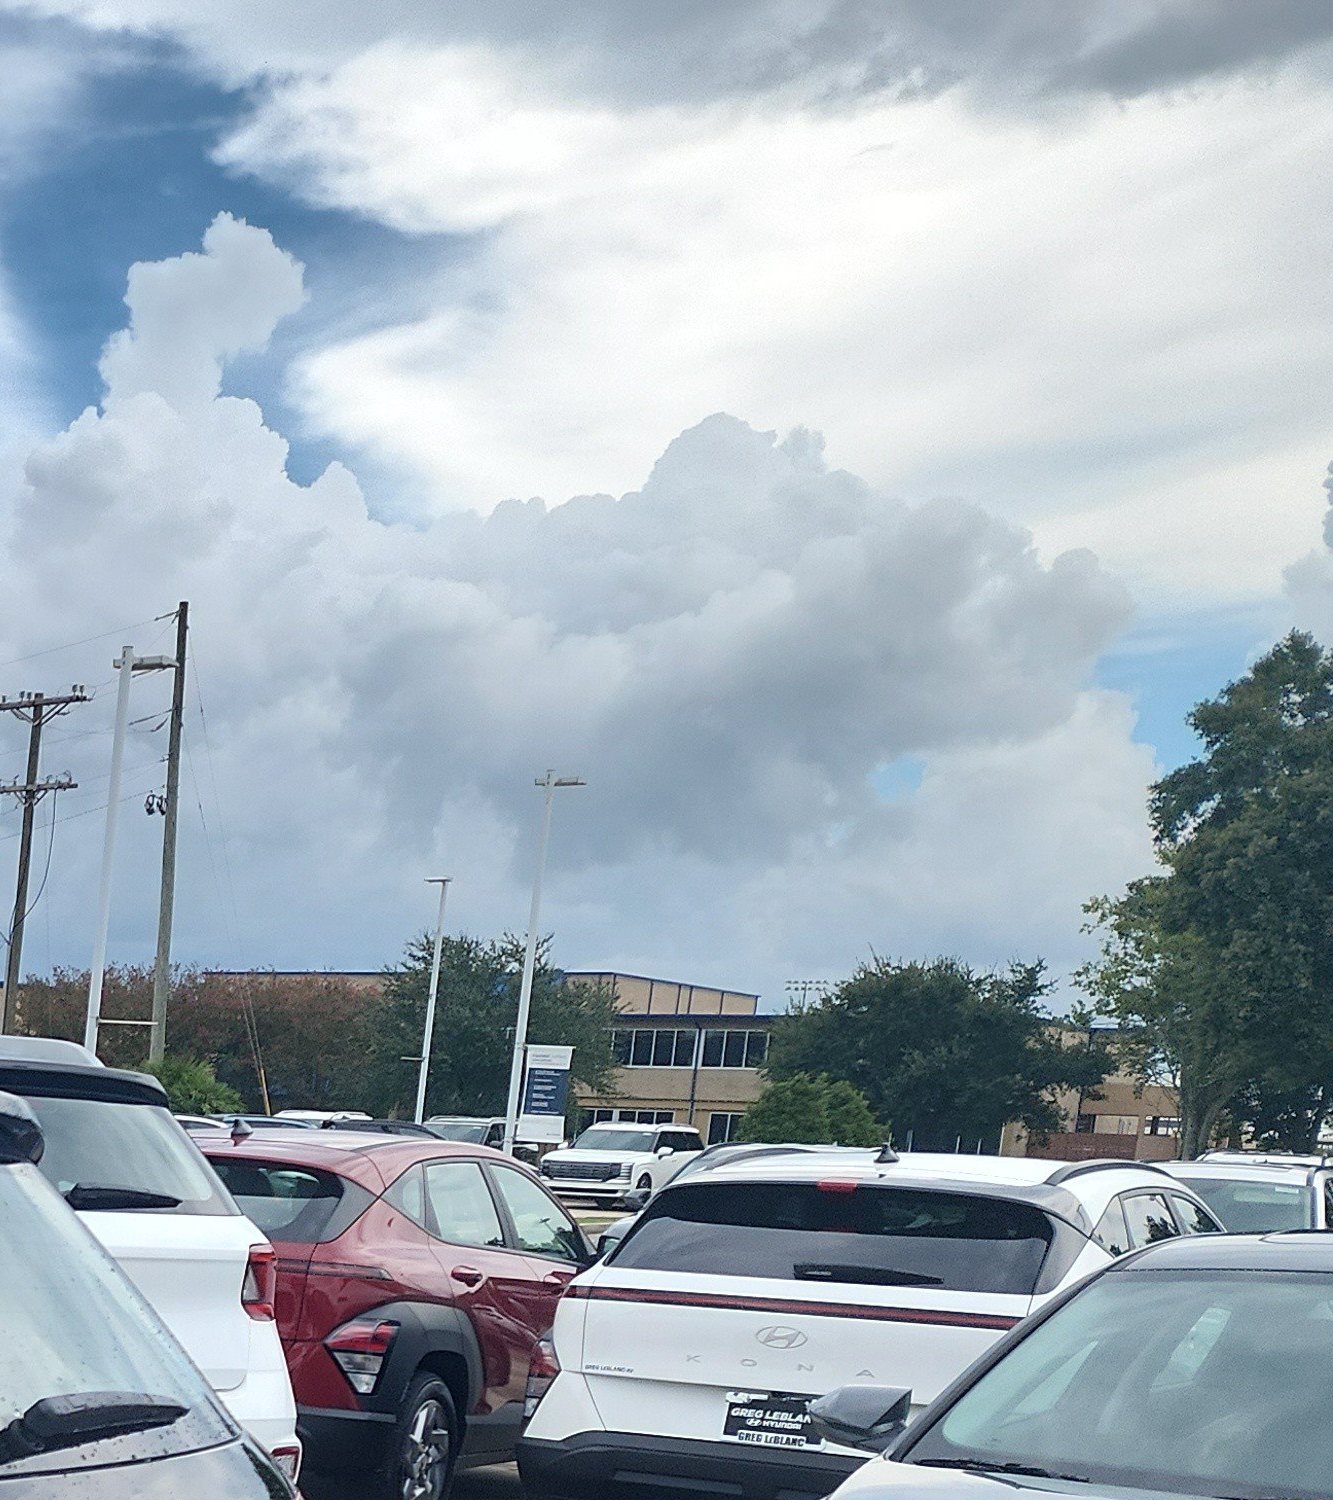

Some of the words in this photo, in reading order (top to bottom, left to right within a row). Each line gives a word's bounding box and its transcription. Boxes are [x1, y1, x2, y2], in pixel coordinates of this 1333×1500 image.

[686, 1353, 875, 1378] KONA
[731, 1407, 763, 1418] GREG
[765, 1410, 811, 1423] LEBLAN
[762, 1420, 802, 1430] HYUNDAI
[738, 1432, 762, 1442] GREG
